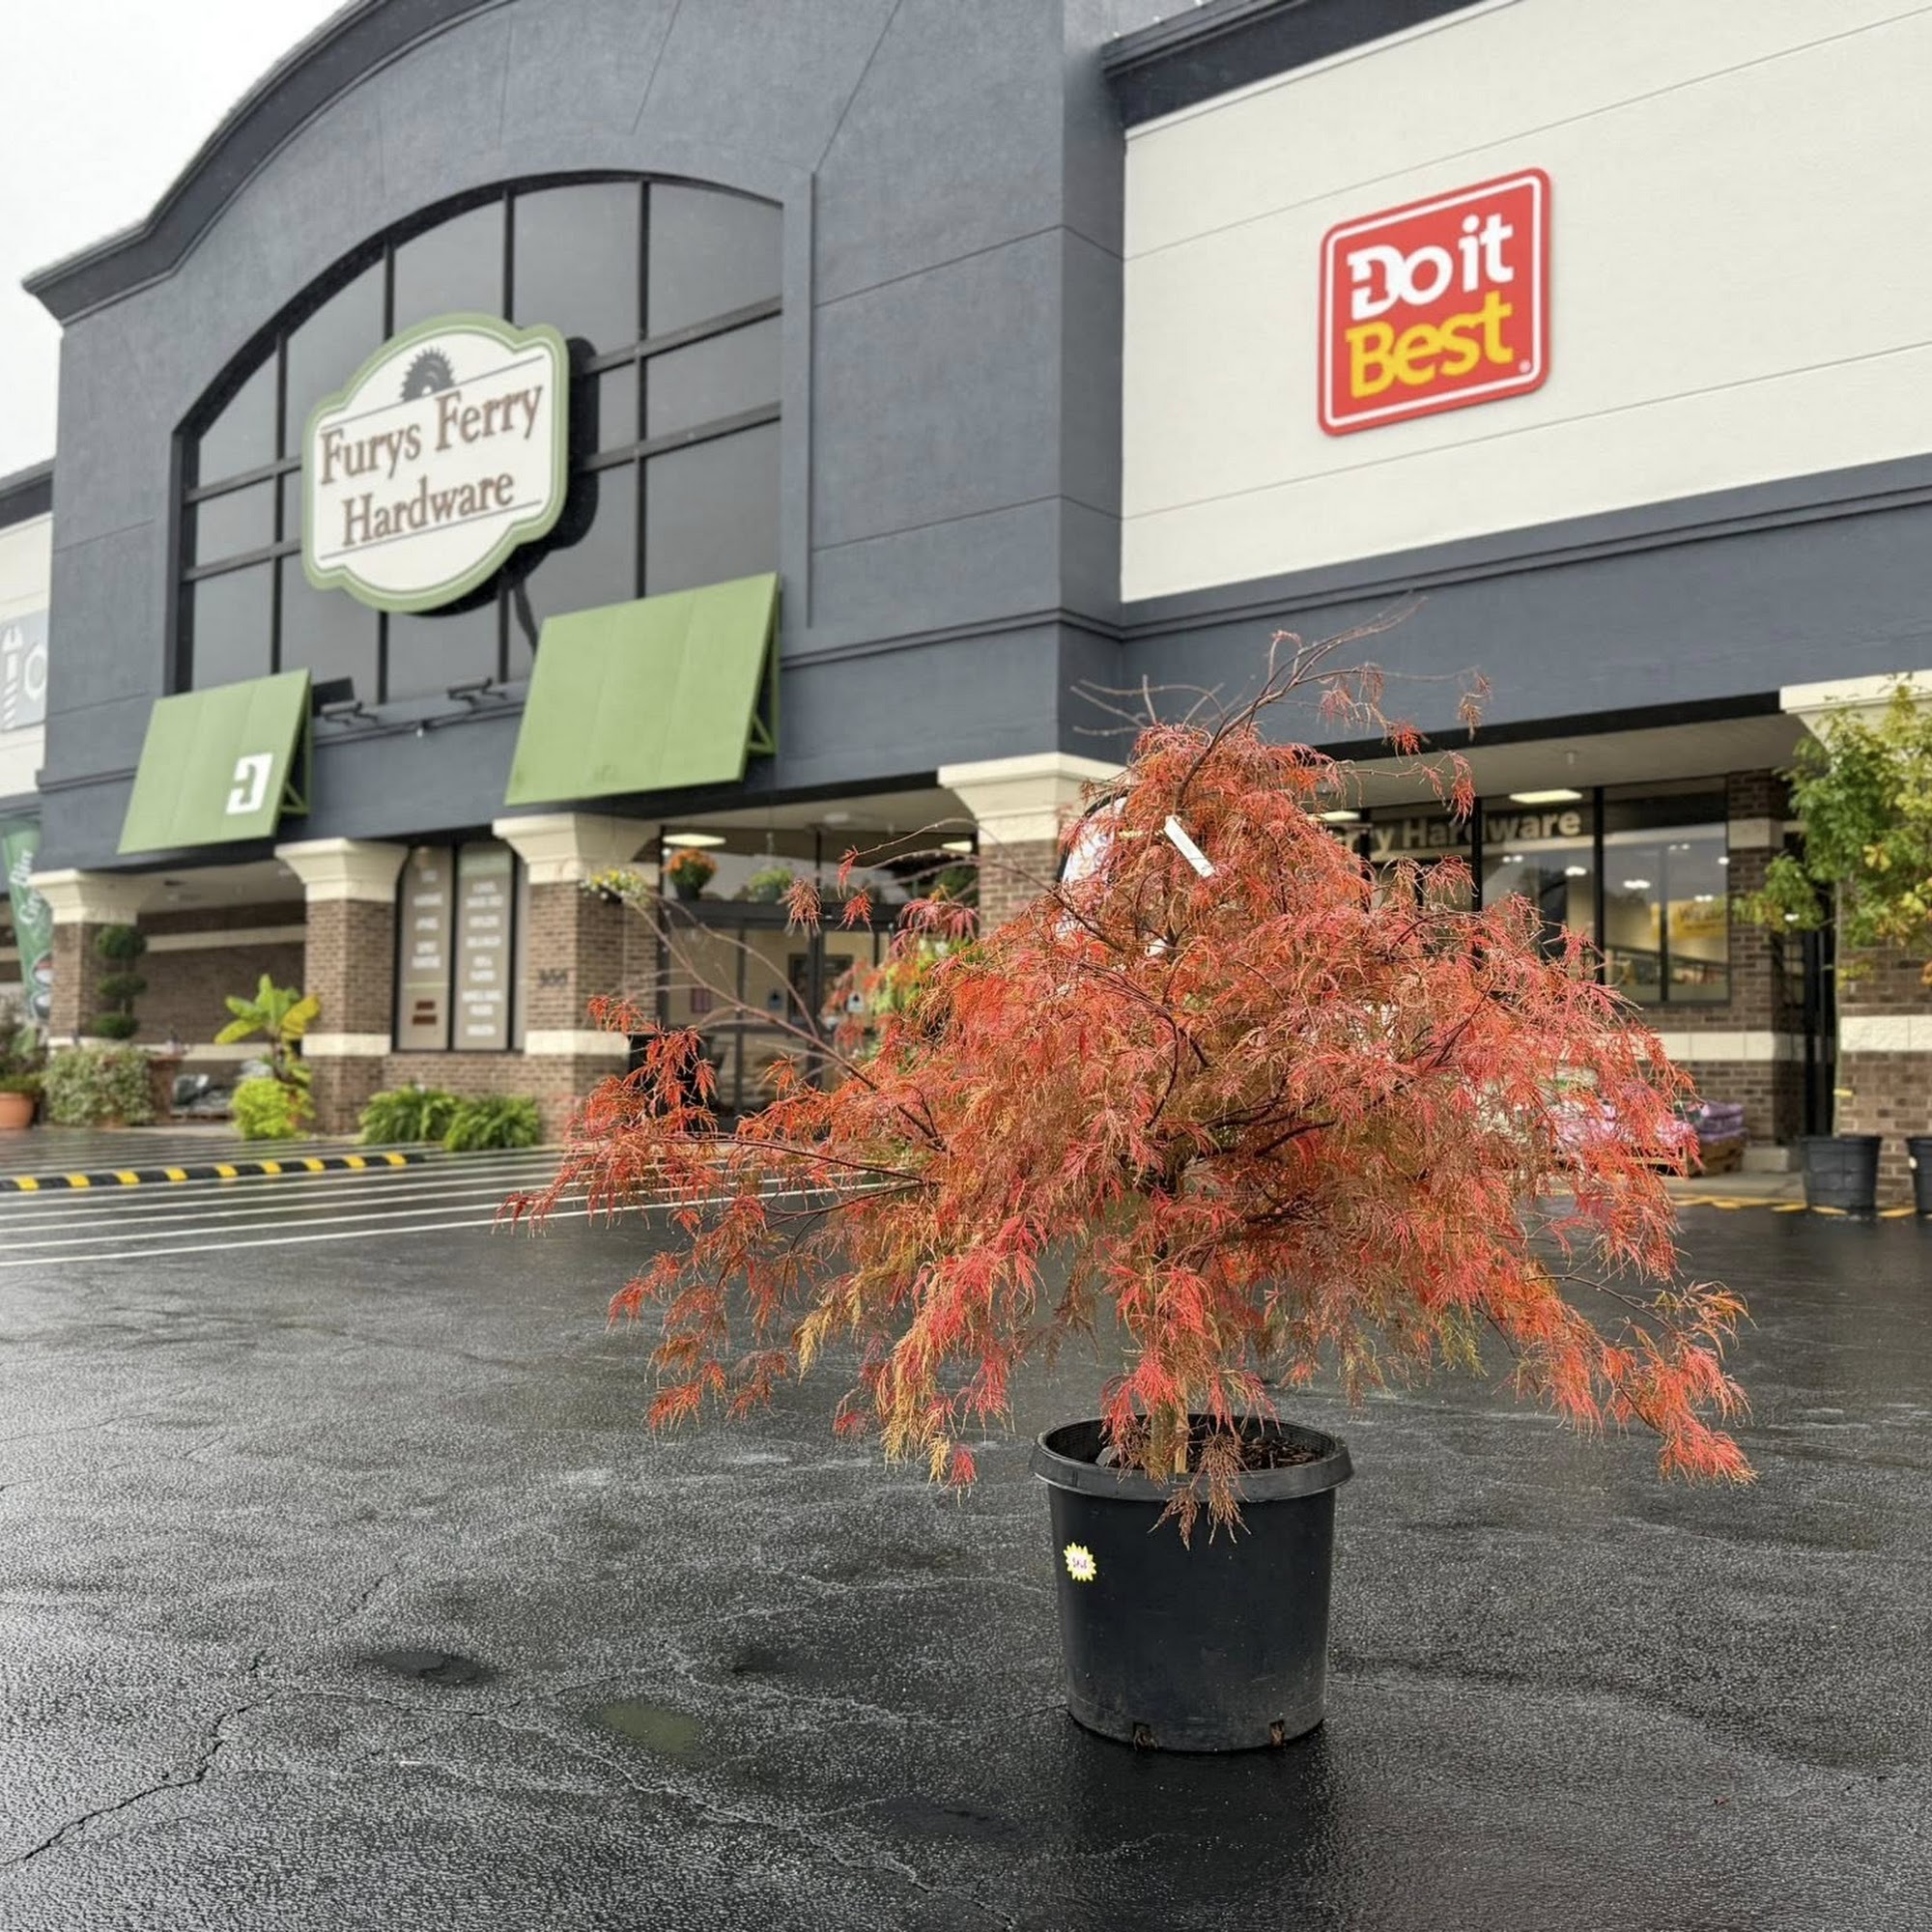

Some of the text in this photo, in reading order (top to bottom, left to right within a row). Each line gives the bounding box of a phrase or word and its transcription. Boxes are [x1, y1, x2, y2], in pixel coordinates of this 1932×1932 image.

[1347, 213, 1514, 321] Do it
[1345, 290, 1514, 400] Best
[320, 384, 543, 486] Furys Ferry
[342, 472, 514, 547] Hardware
